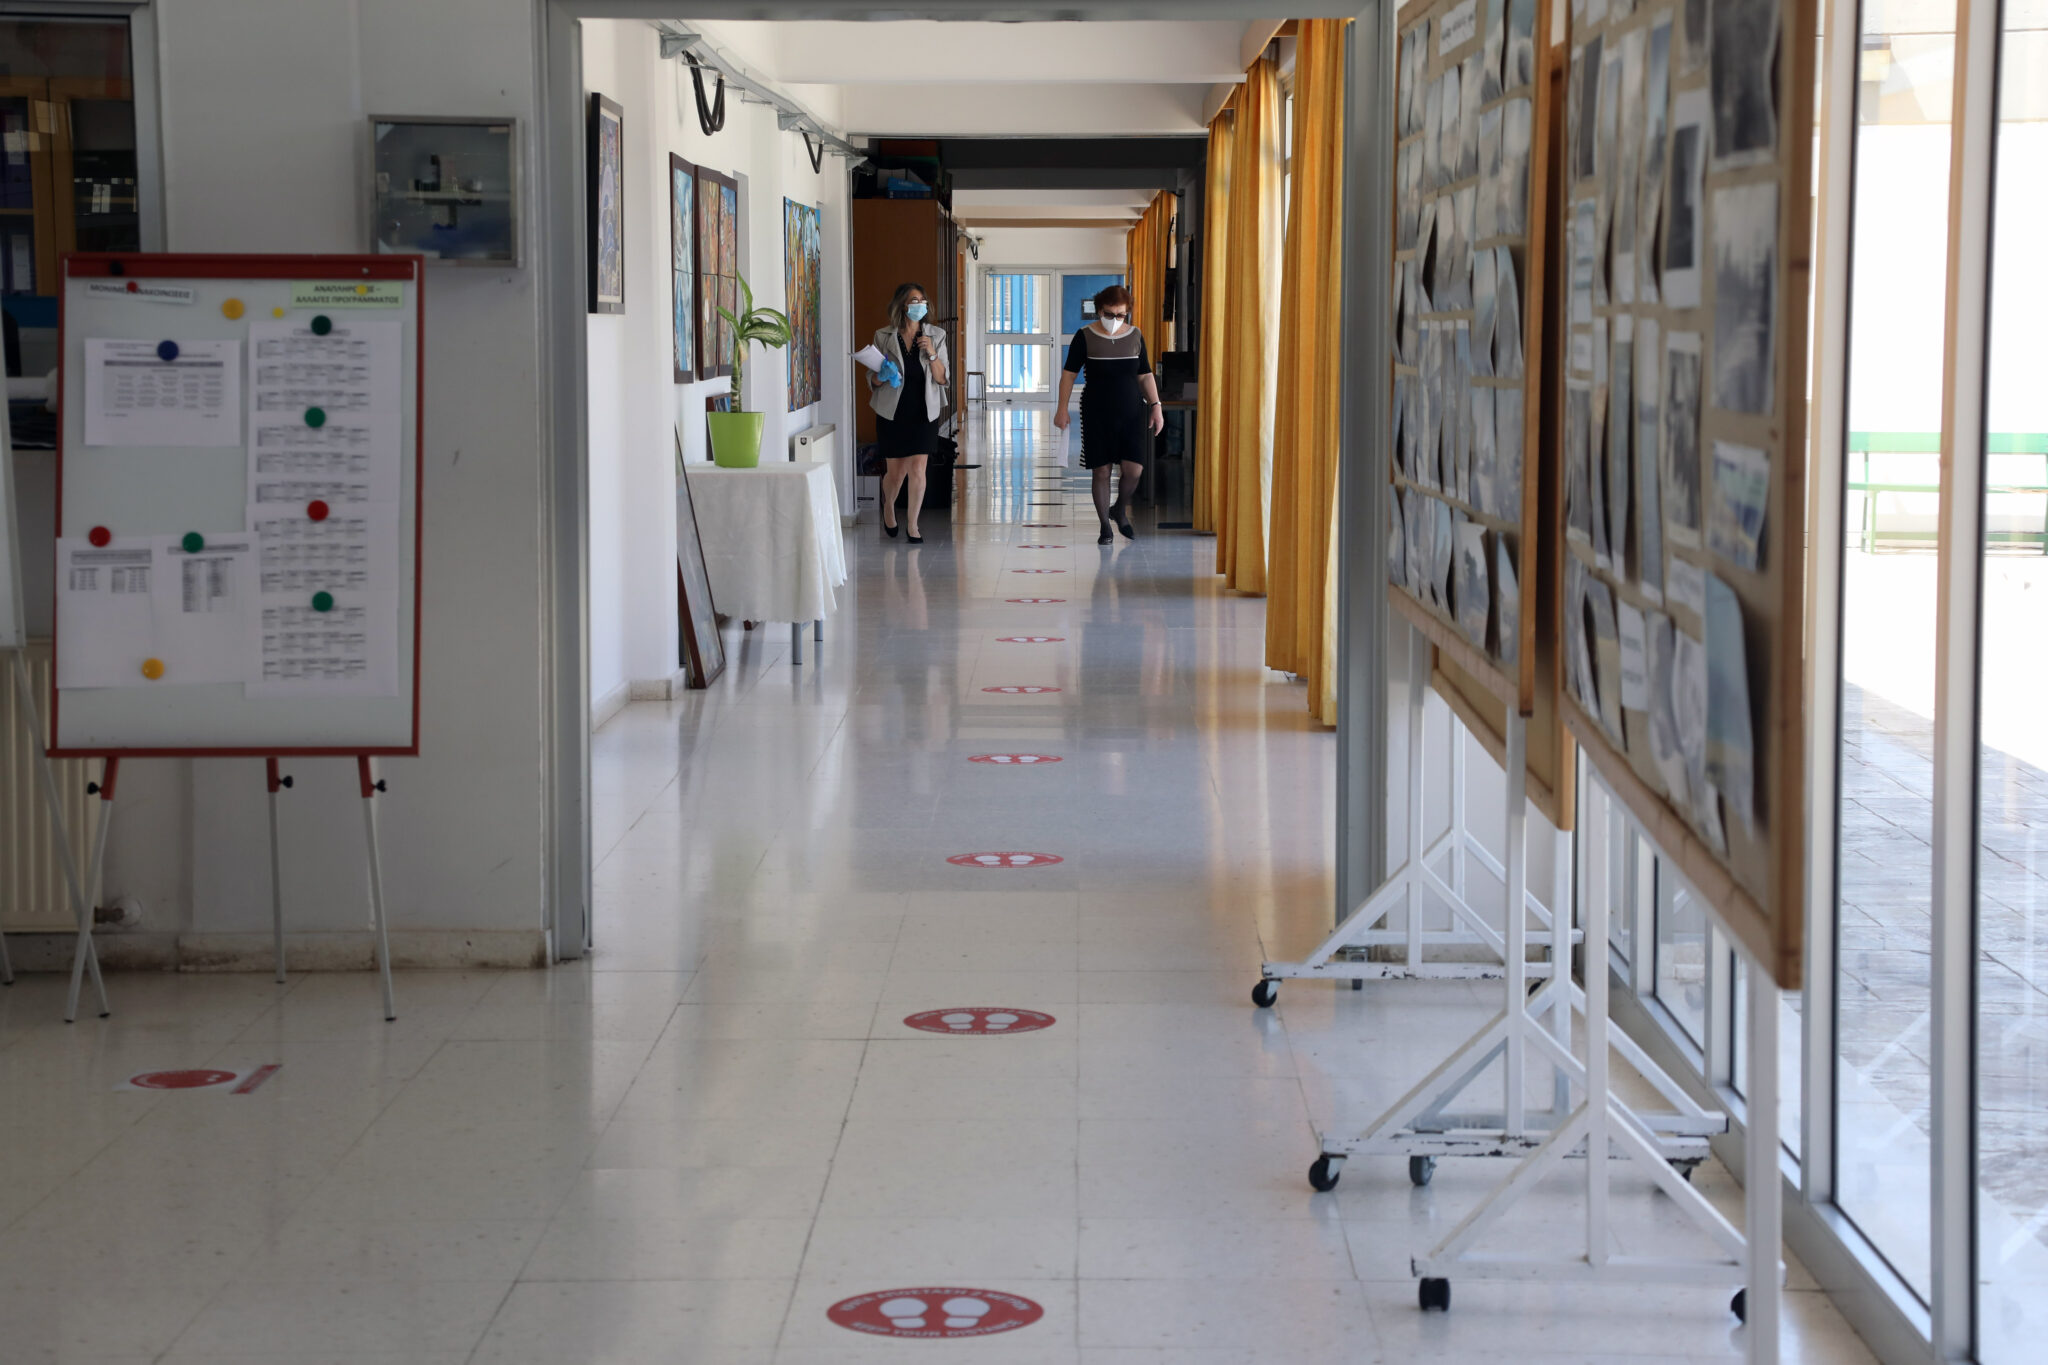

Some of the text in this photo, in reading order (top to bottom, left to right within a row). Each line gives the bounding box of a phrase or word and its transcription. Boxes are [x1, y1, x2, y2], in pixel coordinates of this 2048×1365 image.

[134, 287, 190, 299] ΝΑΚΟΙΝΩΣΕΙΣ
[295, 296, 399, 304] ΑΛΛΑΓΕΣ ΠΡΟΓΡΑΜΜΑΤΟΣ
[893, 1328, 941, 1338] YOUR
